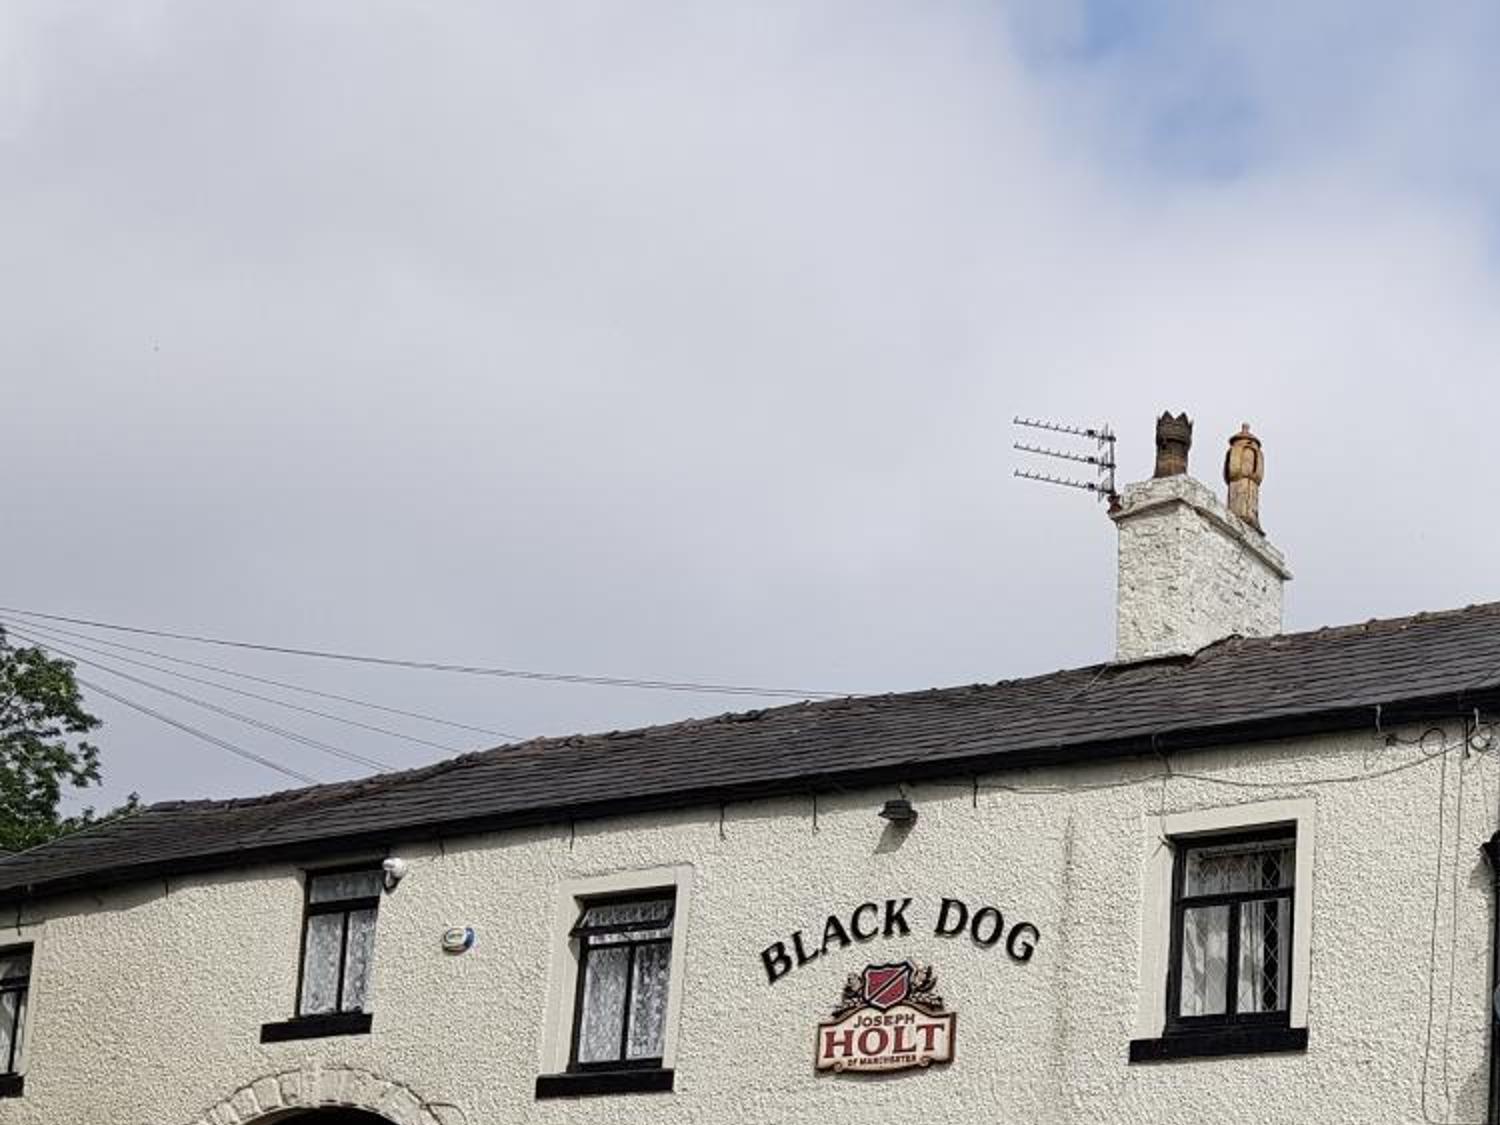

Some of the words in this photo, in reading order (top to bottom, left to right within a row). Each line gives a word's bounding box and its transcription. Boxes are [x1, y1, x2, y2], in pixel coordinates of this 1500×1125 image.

[760, 898, 913, 984] BLACK
[934, 898, 1040, 964] DOG
[853, 1013, 915, 1028] JOSEPH
[823, 1023, 945, 1059] HOLT
